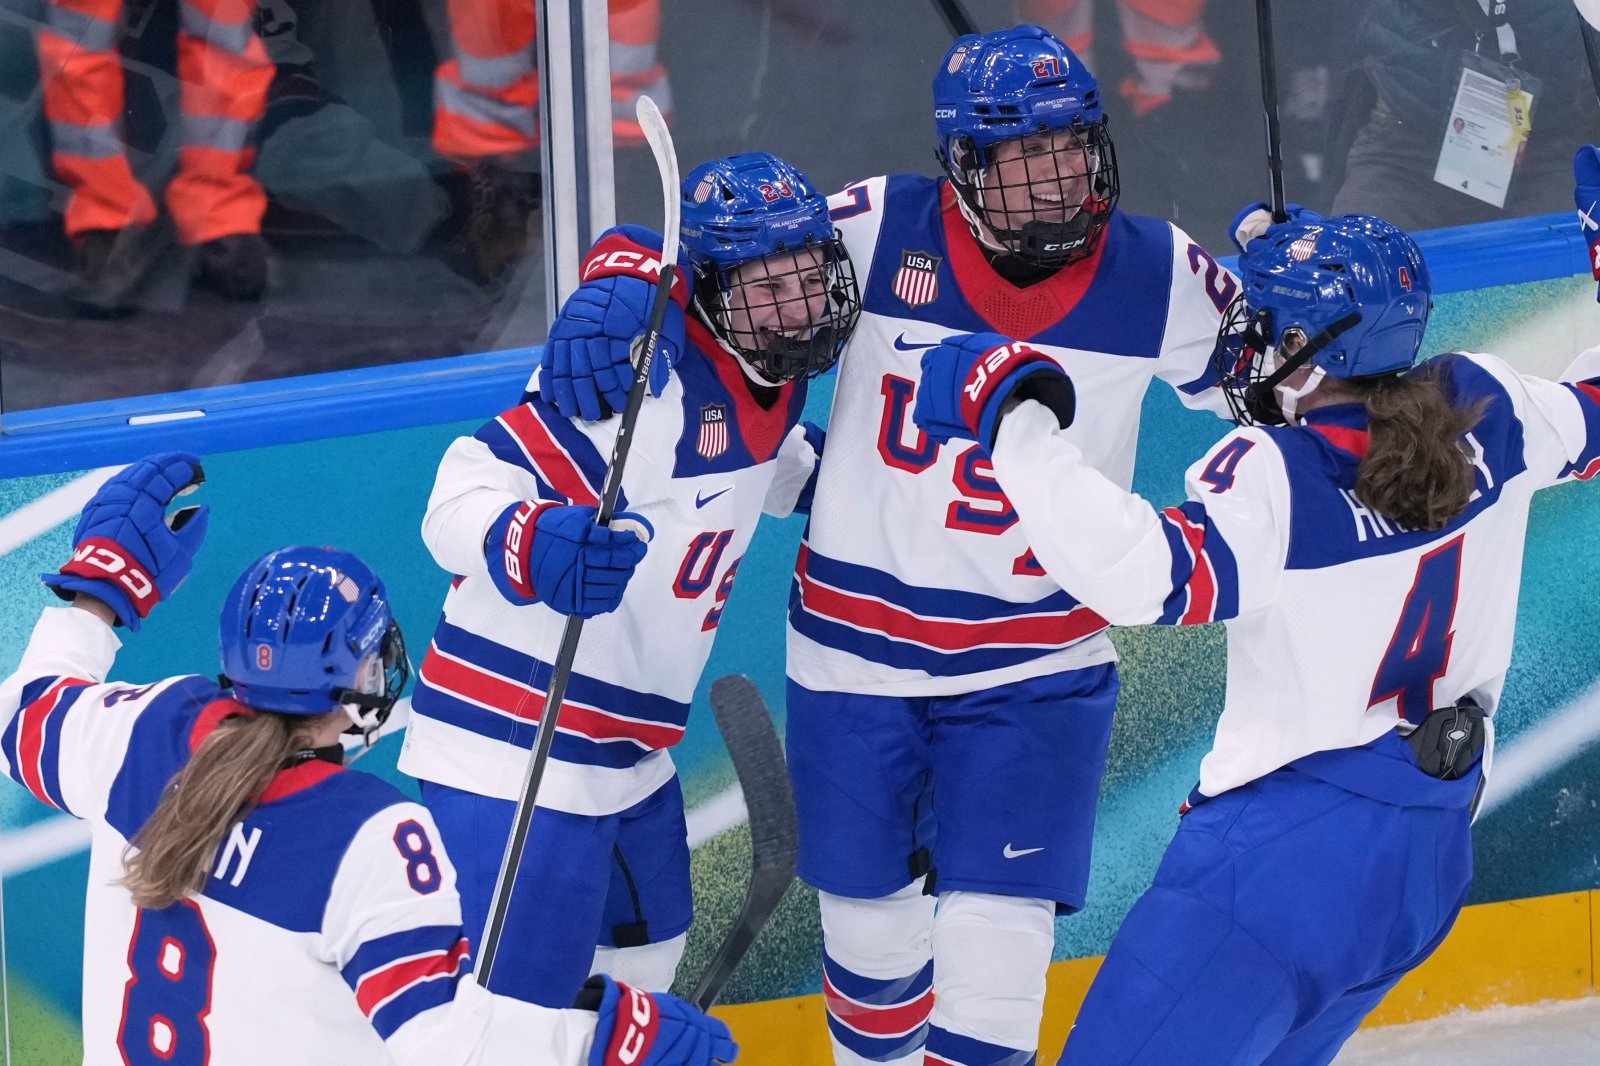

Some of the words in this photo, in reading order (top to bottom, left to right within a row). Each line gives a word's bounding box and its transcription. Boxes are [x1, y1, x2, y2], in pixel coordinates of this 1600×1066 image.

[1029, 58, 1060, 79] 27
[935, 109, 957, 118] CCM
[758, 180, 793, 203] 23
[906, 255, 933, 271] USA
[1043, 236, 1087, 252] CCM
[1398, 266, 1412, 293] 4
[641, 330, 658, 376] BAUER
[963, 340, 1042, 402] UER
[705, 410, 723, 423] USA
[877, 372, 1048, 577] US
[1200, 436, 1256, 494] 4
[505, 498, 565, 584] BAU
[1366, 532, 1466, 726] 4
[257, 643, 273, 671] 8
[393, 819, 442, 896] 8
[116, 896, 217, 1066] 8
[618, 987, 651, 1065] CC
